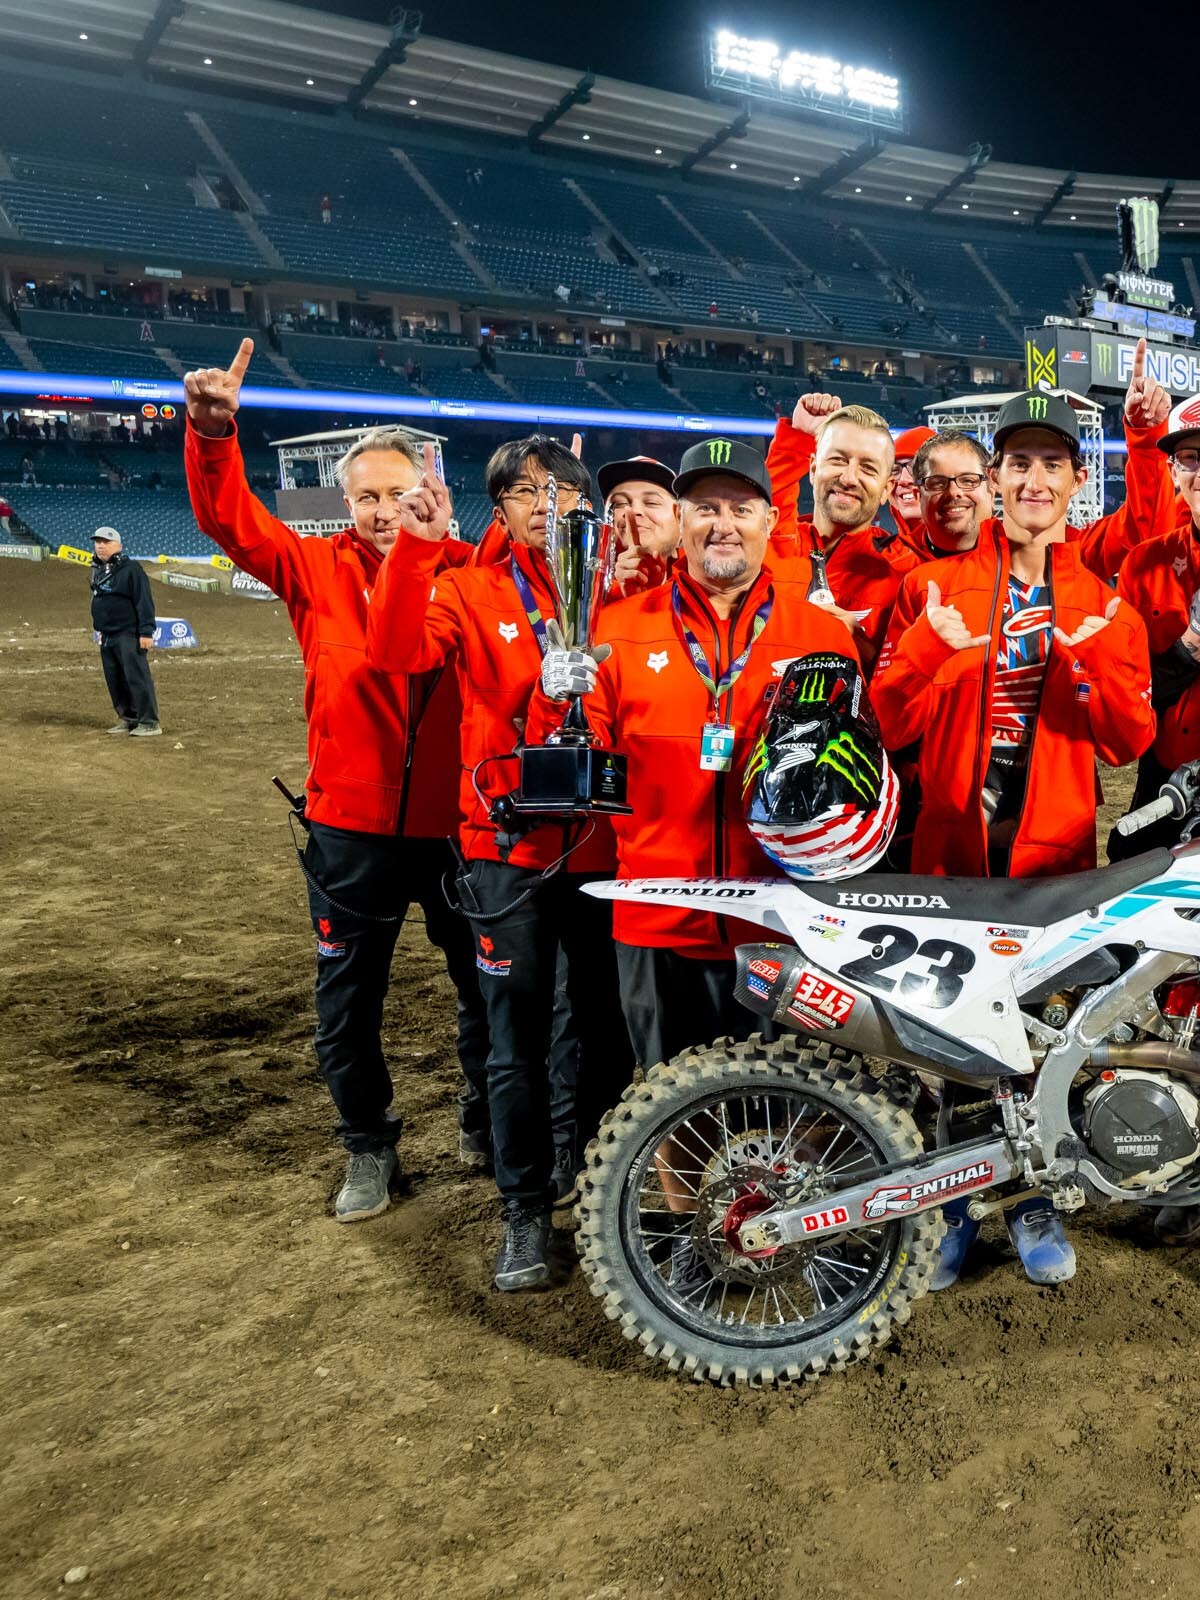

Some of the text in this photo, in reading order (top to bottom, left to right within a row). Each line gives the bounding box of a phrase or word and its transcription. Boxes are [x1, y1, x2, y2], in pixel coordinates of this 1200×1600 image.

[1119, 274, 1175, 300] MONSTER
[0, 546, 29, 555] NSTER
[794, 660, 848, 672] MONSTER
[635, 888, 756, 898] DUNLOP
[836, 892, 950, 909] HONDA
[993, 943, 1009, 951] Twin
[838, 924, 976, 1009] 23
[794, 975, 853, 1018] ヨシムラ
[1113, 1135, 1162, 1143] HONDA
[864, 1163, 991, 1217] RENTHAL
[803, 1208, 848, 1232] D.I.D
